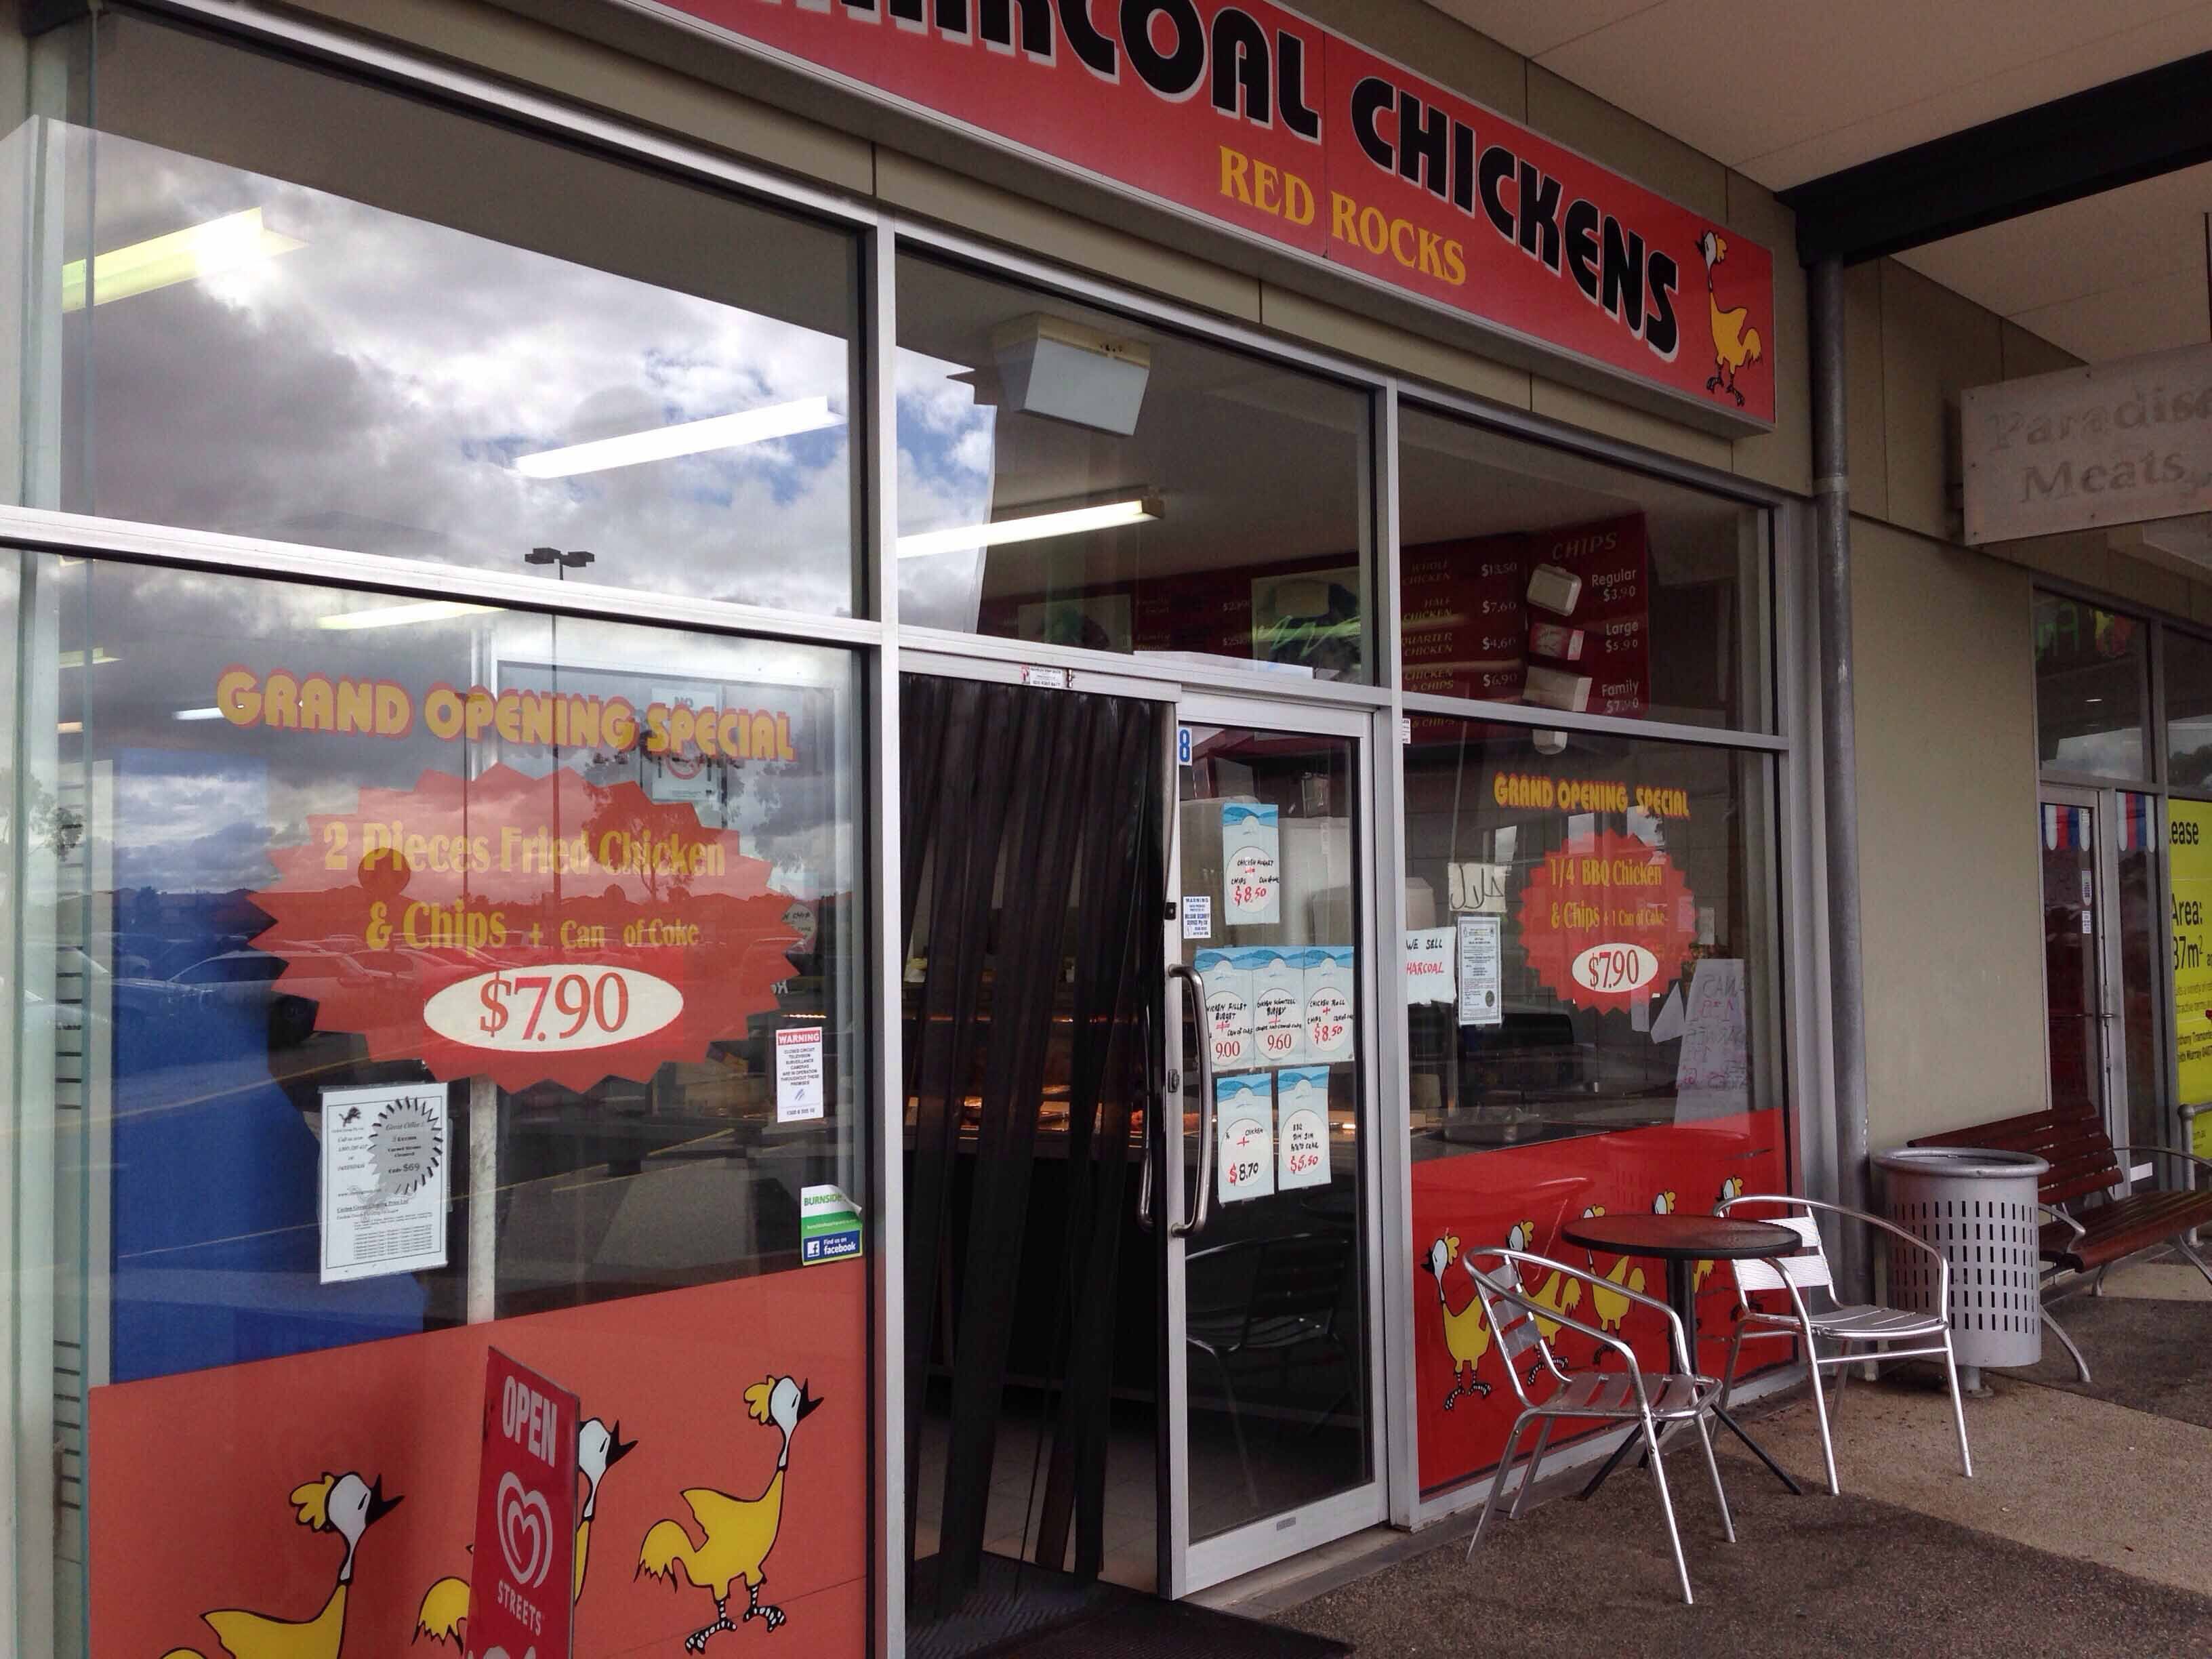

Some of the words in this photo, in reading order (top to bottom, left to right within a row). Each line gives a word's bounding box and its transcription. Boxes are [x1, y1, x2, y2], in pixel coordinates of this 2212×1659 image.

[752, 0, 1323, 144] COAL
[1351, 76, 1679, 363] CHICKENS
[1219, 145, 1315, 227] RED
[1331, 190, 1467, 287] ROCKS
[1551, 531, 1617, 561] CHIPS
[1592, 568, 1637, 587] Regular
[1605, 619, 1639, 636] Large
[1601, 679, 1639, 697] Family
[218, 664, 413, 739] GRAND
[424, 681, 640, 754] OPENING
[646, 701, 798, 763] SPECIAL
[1494, 771, 1555, 809] GRAND
[1556, 778, 1629, 813] OPENING
[1635, 784, 1692, 819] SPECIAL
[2169, 819, 2199, 846] ease
[324, 821, 348, 872] 2
[362, 819, 491, 874] Pieces
[499, 825, 590, 876] Fried
[598, 829, 726, 877] Chicken
[1551, 857, 1575, 888] 1/4
[1582, 858, 1610, 889] BBQ
[1612, 857, 1662, 886] Chicken
[1551, 901, 1561, 929] &
[1563, 900, 1600, 933] Chips
[2172, 893, 2203, 926] Area:
[365, 901, 394, 949] &
[403, 897, 507, 959] Chips
[560, 920, 606, 949] Can
[622, 918, 649, 947] of
[649, 918, 701, 947] Coke
[1406, 938, 1419, 950] WE
[1426, 938, 1443, 949] SELL
[1406, 961, 1445, 975] HARCOAL
[1588, 949, 1640, 989] $7.90
[480, 970, 629, 1042] $7.90
[779, 1033, 819, 1044] WARNING
[1267, 1033, 1292, 1051] 9.60
[1315, 1022, 1343, 1044] $8.50
[1215, 1040, 1240, 1059] 9.00
[1245, 1128, 1264, 1136] CHICKEN
[1229, 1162, 1258, 1187] $8.70
[824, 1242, 856, 1255] facebook
[501, 1375, 558, 1468] OPEN
[497, 1580, 541, 1637] STREETS
